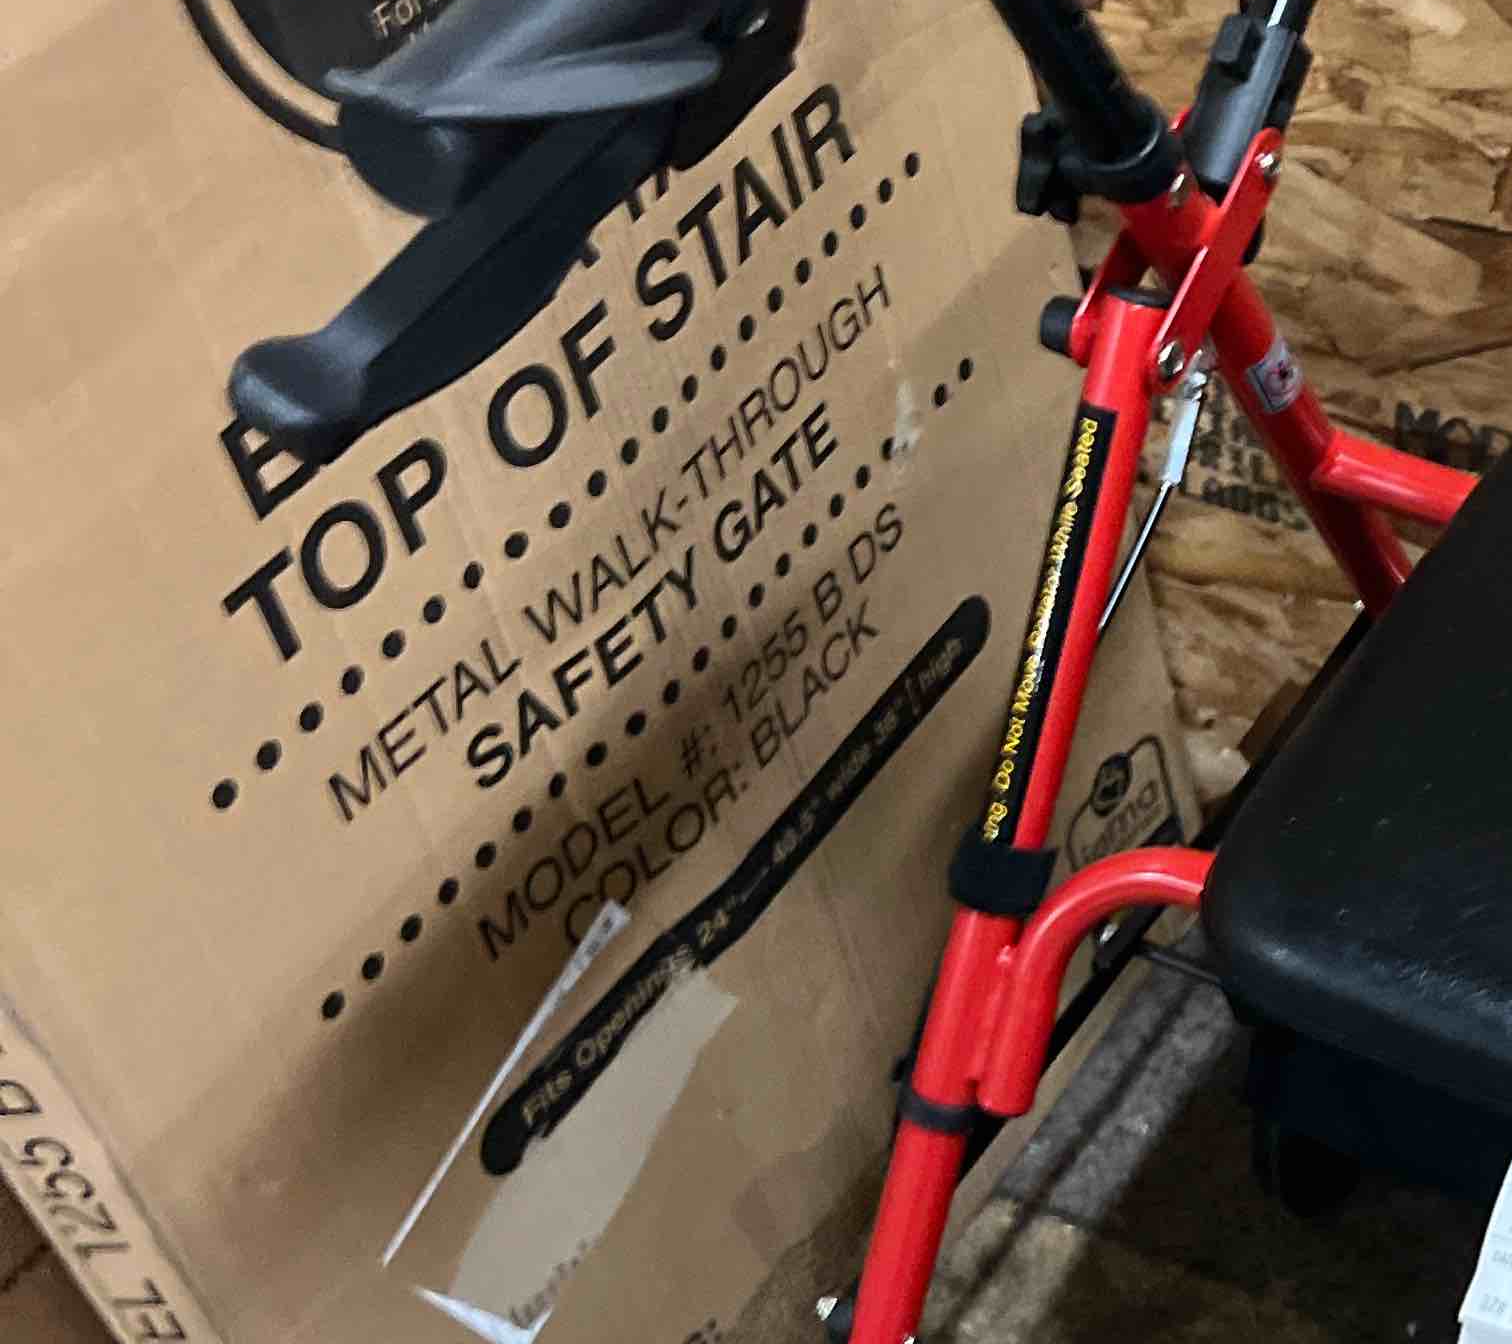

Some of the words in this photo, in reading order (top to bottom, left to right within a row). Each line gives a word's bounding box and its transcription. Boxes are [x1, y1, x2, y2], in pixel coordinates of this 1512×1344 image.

[223, 438, 446, 661] TOP
[486, 301, 617, 468] OF
[634, 83, 856, 342] STAIR
[329, 640, 522, 822] METAL
[524, 265, 893, 645] WALK-THROUGH
[466, 551, 697, 788] SAFETY
[713, 402, 839, 563] GATE
[476, 775, 671, 963] MODEL
[722, 611, 808, 721] 1255
[812, 567, 844, 620] B
[843, 504, 905, 582] DS
[751, 601, 879, 769] BLACK
[994, 759, 1015, 791] Do
[1003, 716, 1025, 754] Not
[24, 1136, 131, 1261] 1255
